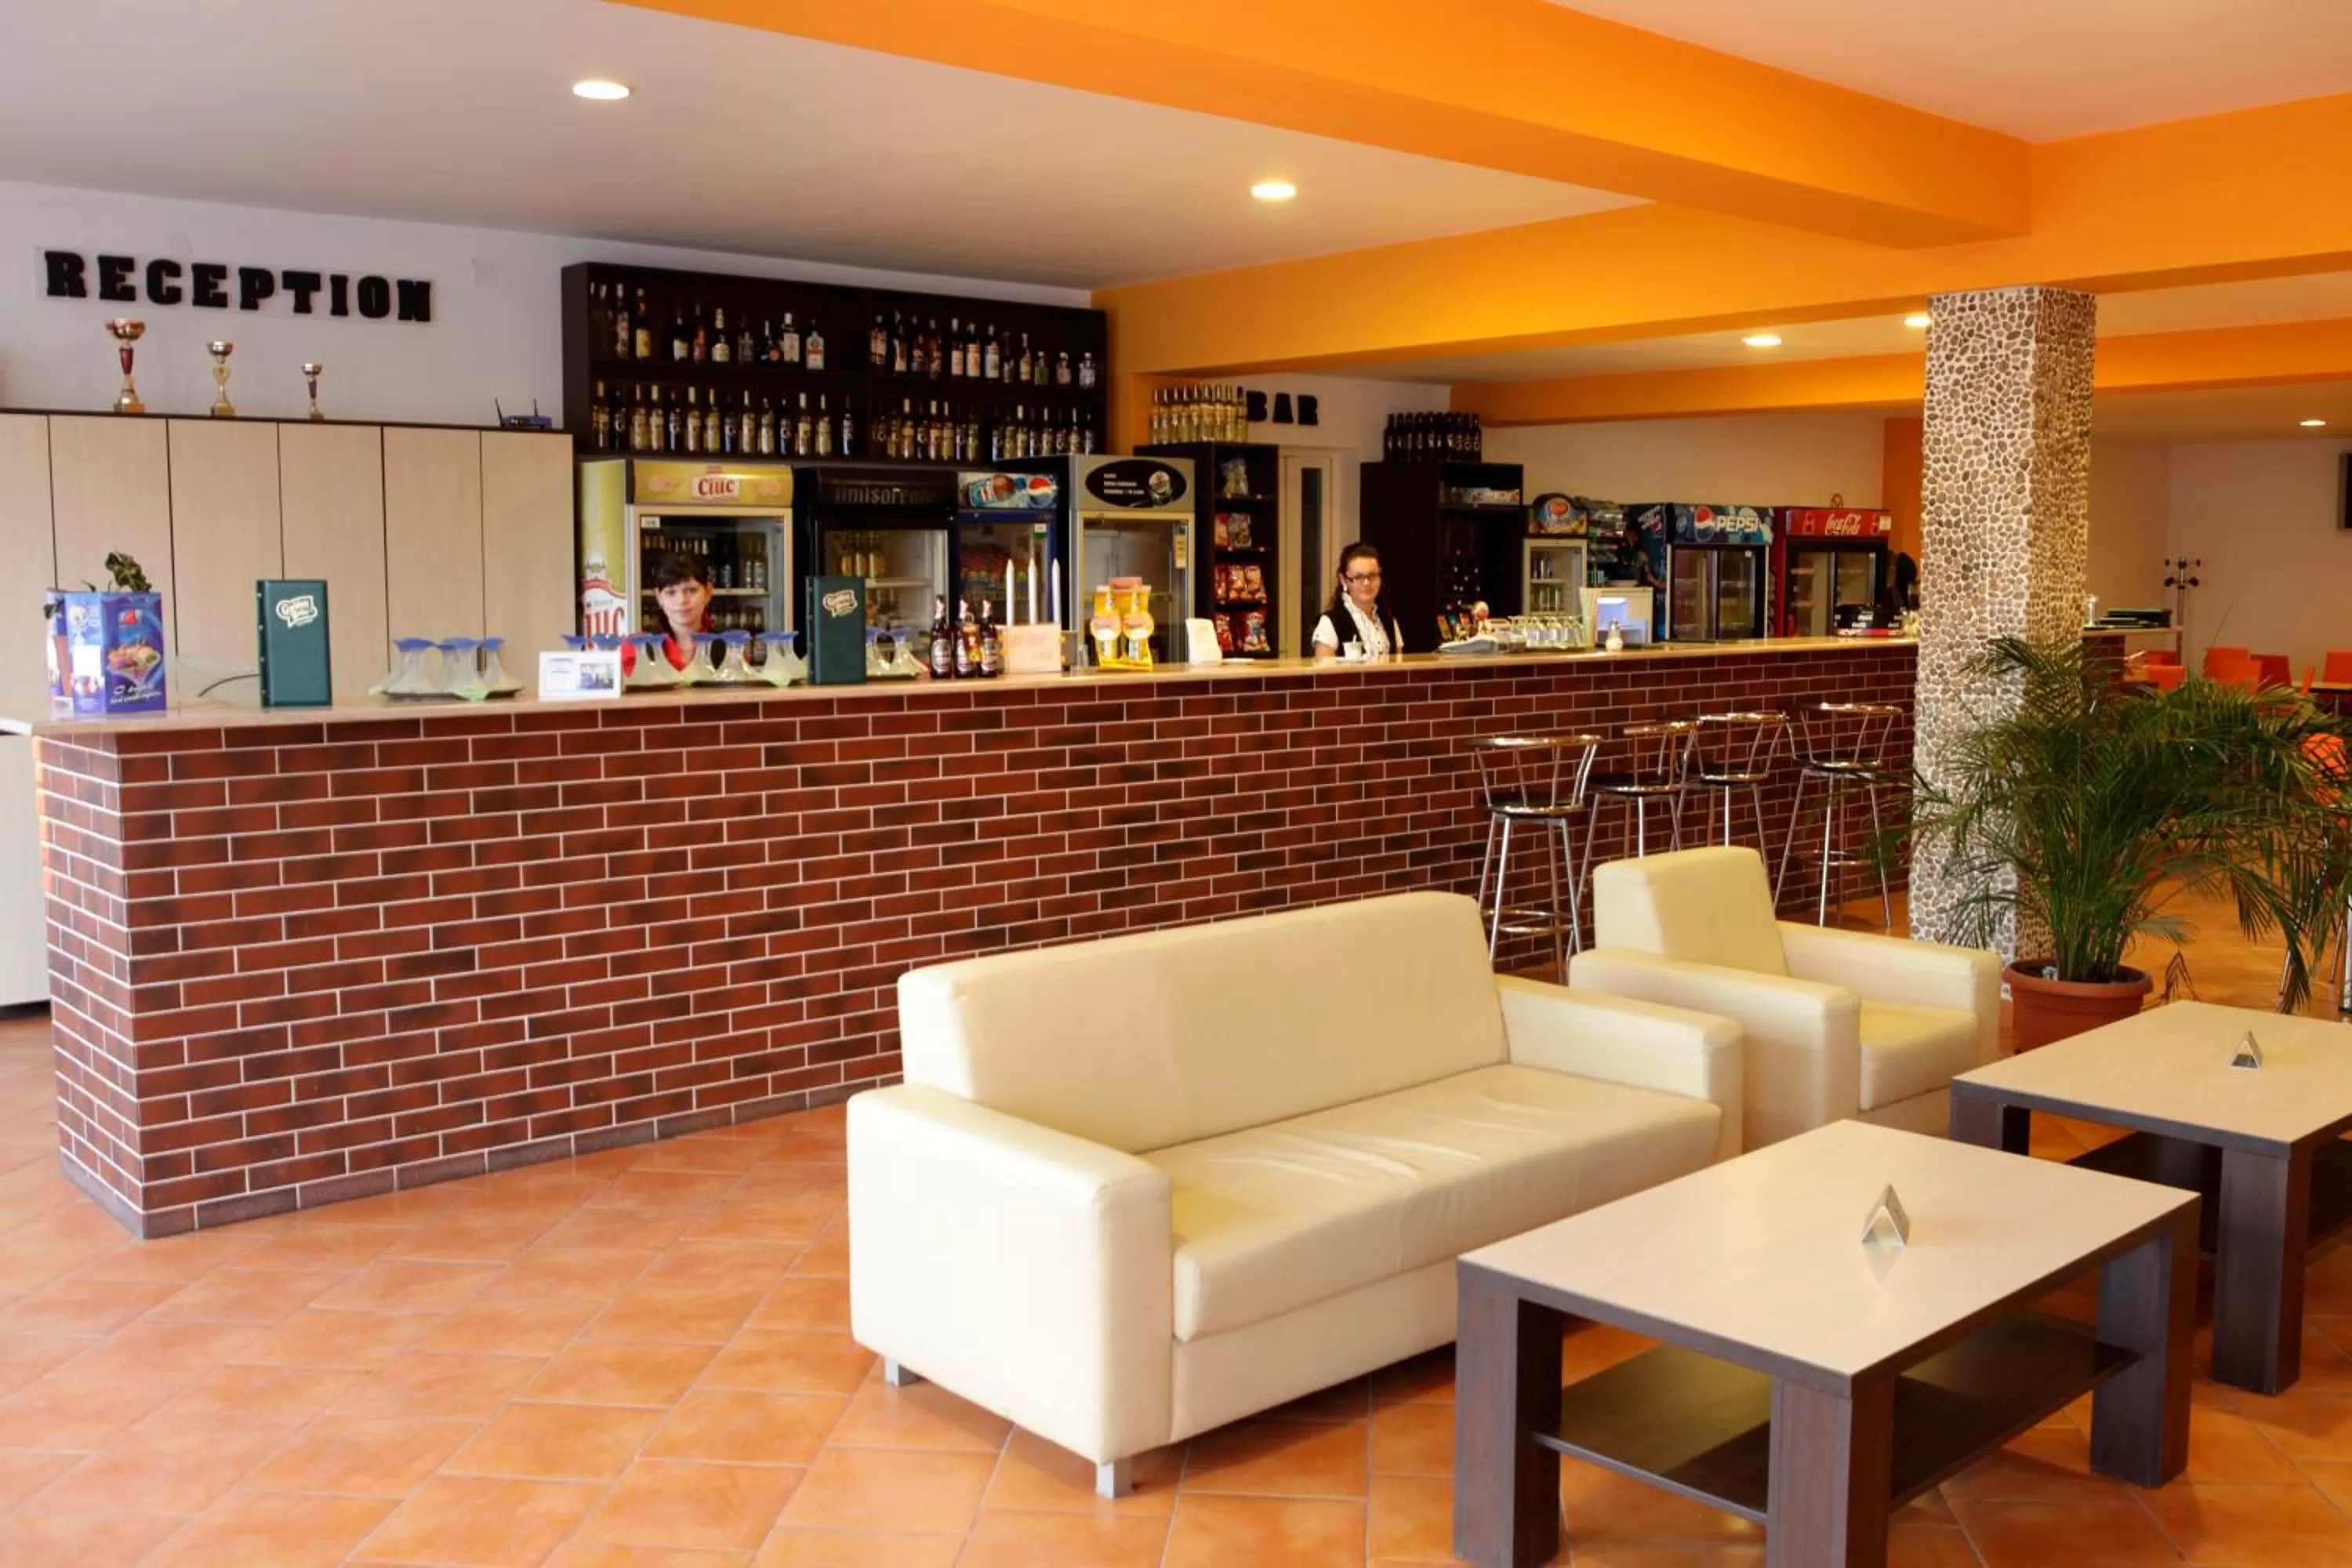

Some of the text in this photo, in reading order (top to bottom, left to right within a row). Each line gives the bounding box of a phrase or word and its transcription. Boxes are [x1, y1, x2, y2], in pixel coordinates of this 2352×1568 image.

[44, 249, 432, 322] RECEPTION
[1247, 390, 1318, 425] BAR
[698, 477, 735, 496] Ciuc
[1715, 515, 1759, 534] PEPSI
